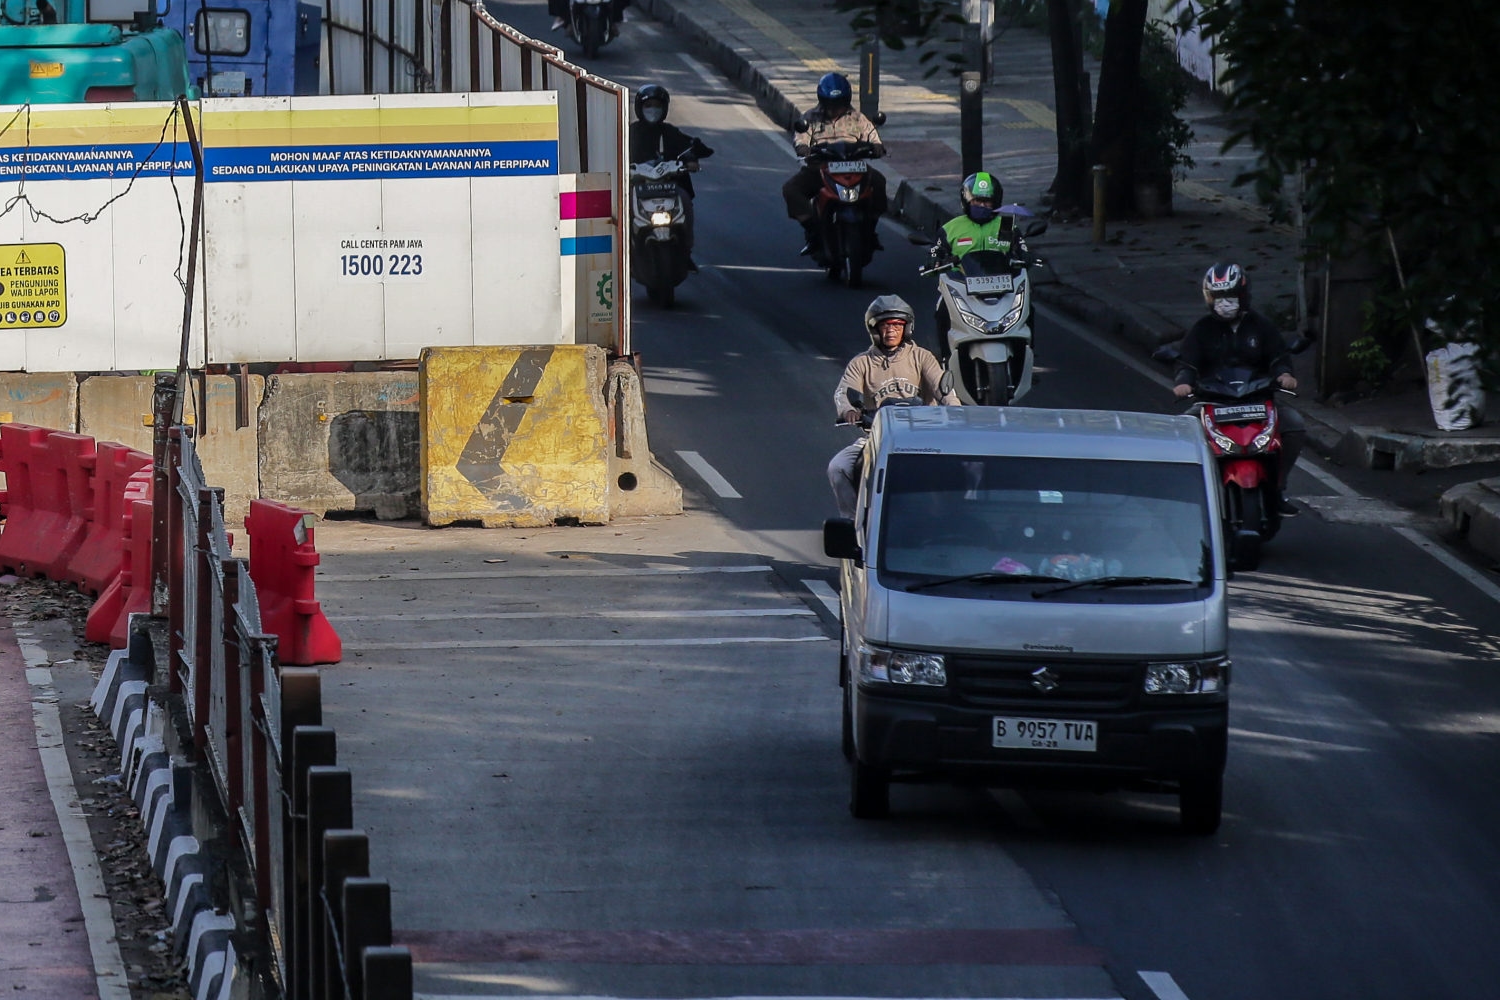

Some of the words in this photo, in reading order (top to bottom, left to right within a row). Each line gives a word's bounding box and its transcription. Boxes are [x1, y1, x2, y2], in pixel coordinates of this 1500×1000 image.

[11, 150, 134, 162] KETIDAKNYAMANANNYA
[270, 152, 310, 162] MOHON
[312, 151, 341, 161] MAAF
[343, 151, 368, 160] ATAS
[370, 148, 491, 160] KETIDAKNYAMANANNYA
[66, 163, 114, 173] LAYANAN
[116, 161, 133, 171] AIR
[135, 160, 192, 171] PERPIPAAN
[212, 165, 254, 175] SEDANG
[257, 164, 316, 174] DILAKUKAN
[317, 163, 349, 173] UPAYA
[352, 162, 423, 172] PENINGKATAN
[425, 160, 472, 171] LAYANAN
[474, 160, 491, 169] AIR
[493, 159, 549, 169] PERPIPAAN
[341, 239, 359, 248] CALL
[360, 239, 388, 248] CENTER
[389, 239, 405, 248] PAM
[406, 239, 423, 248] JAYA
[14, 265, 59, 276] TERBATAS
[341, 254, 383, 275] 1500
[389, 254, 422, 275] 223
[10, 279, 59, 288] PENGUNJUNG
[11, 289, 32, 297] WAJIB
[34, 288, 59, 296] LAPOR
[11, 300, 44, 309] GUNAKAN
[46, 300, 60, 308] APD
[997, 720, 1006, 737] B
[1017, 721, 1057, 739] 9957
[1064, 722, 1094, 741] TVA
